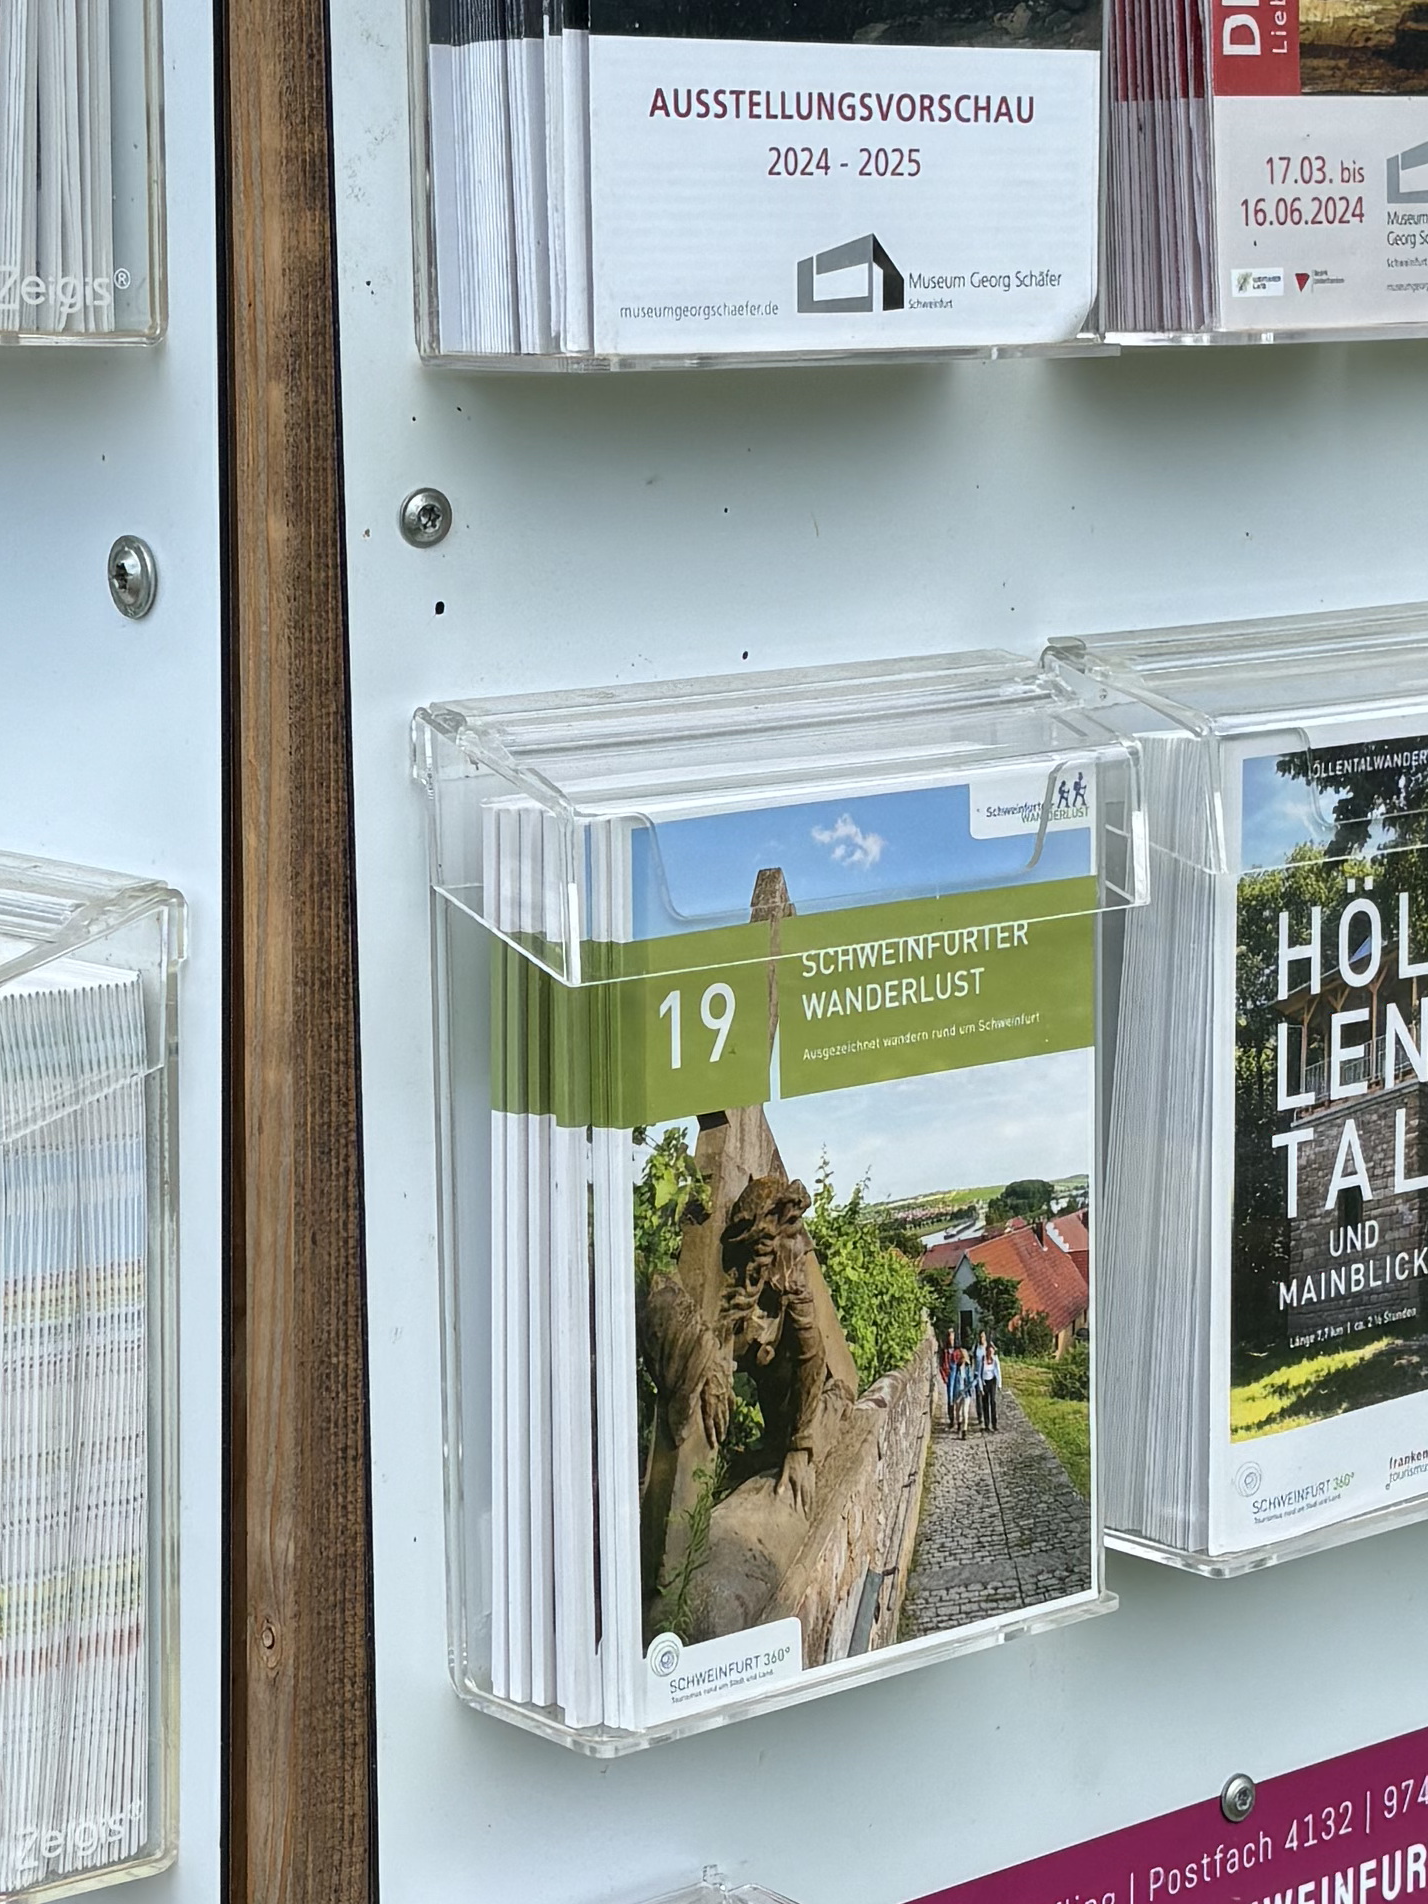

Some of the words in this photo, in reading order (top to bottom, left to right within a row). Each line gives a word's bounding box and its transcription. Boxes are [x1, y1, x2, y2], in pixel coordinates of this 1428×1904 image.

[649, 87, 1036, 123] AUSSTELLUNGSVORSCHAU
[768, 147, 831, 176] 2024
[858, 147, 921, 177] 2025
[1266, 156, 1334, 186] 17.03.
[1340, 159, 1365, 183] bis
[1241, 196, 1364, 227] 16.06.2024
[909, 272, 966, 290] Museum
[970, 271, 1011, 293] Georg
[1016, 270, 1062, 288] Schäfer
[619, 300, 779, 321] museumgeorgschaefer.de
[801, 921, 1029, 978] SCHWEINFURTER
[801, 967, 985, 1021] WANDERLUST
[659, 982, 737, 1070] 19
[802, 1036, 880, 1061] Ausgezeichnet
[883, 1031, 928, 1050] wandern
[932, 1024, 956, 1040] rund
[959, 1023, 975, 1035] um
[978, 1012, 1041, 1032] Schweinfurt
[1329, 1219, 1379, 1257] UND
[1279, 1247, 1428, 1311] MAINBLICK
[669, 1657, 761, 1694] SCHWEINFURT
[763, 1646, 791, 1669] 360°
[1148, 1832, 1275, 1902] Postfach
[1284, 1800, 1355, 1854] 4132
